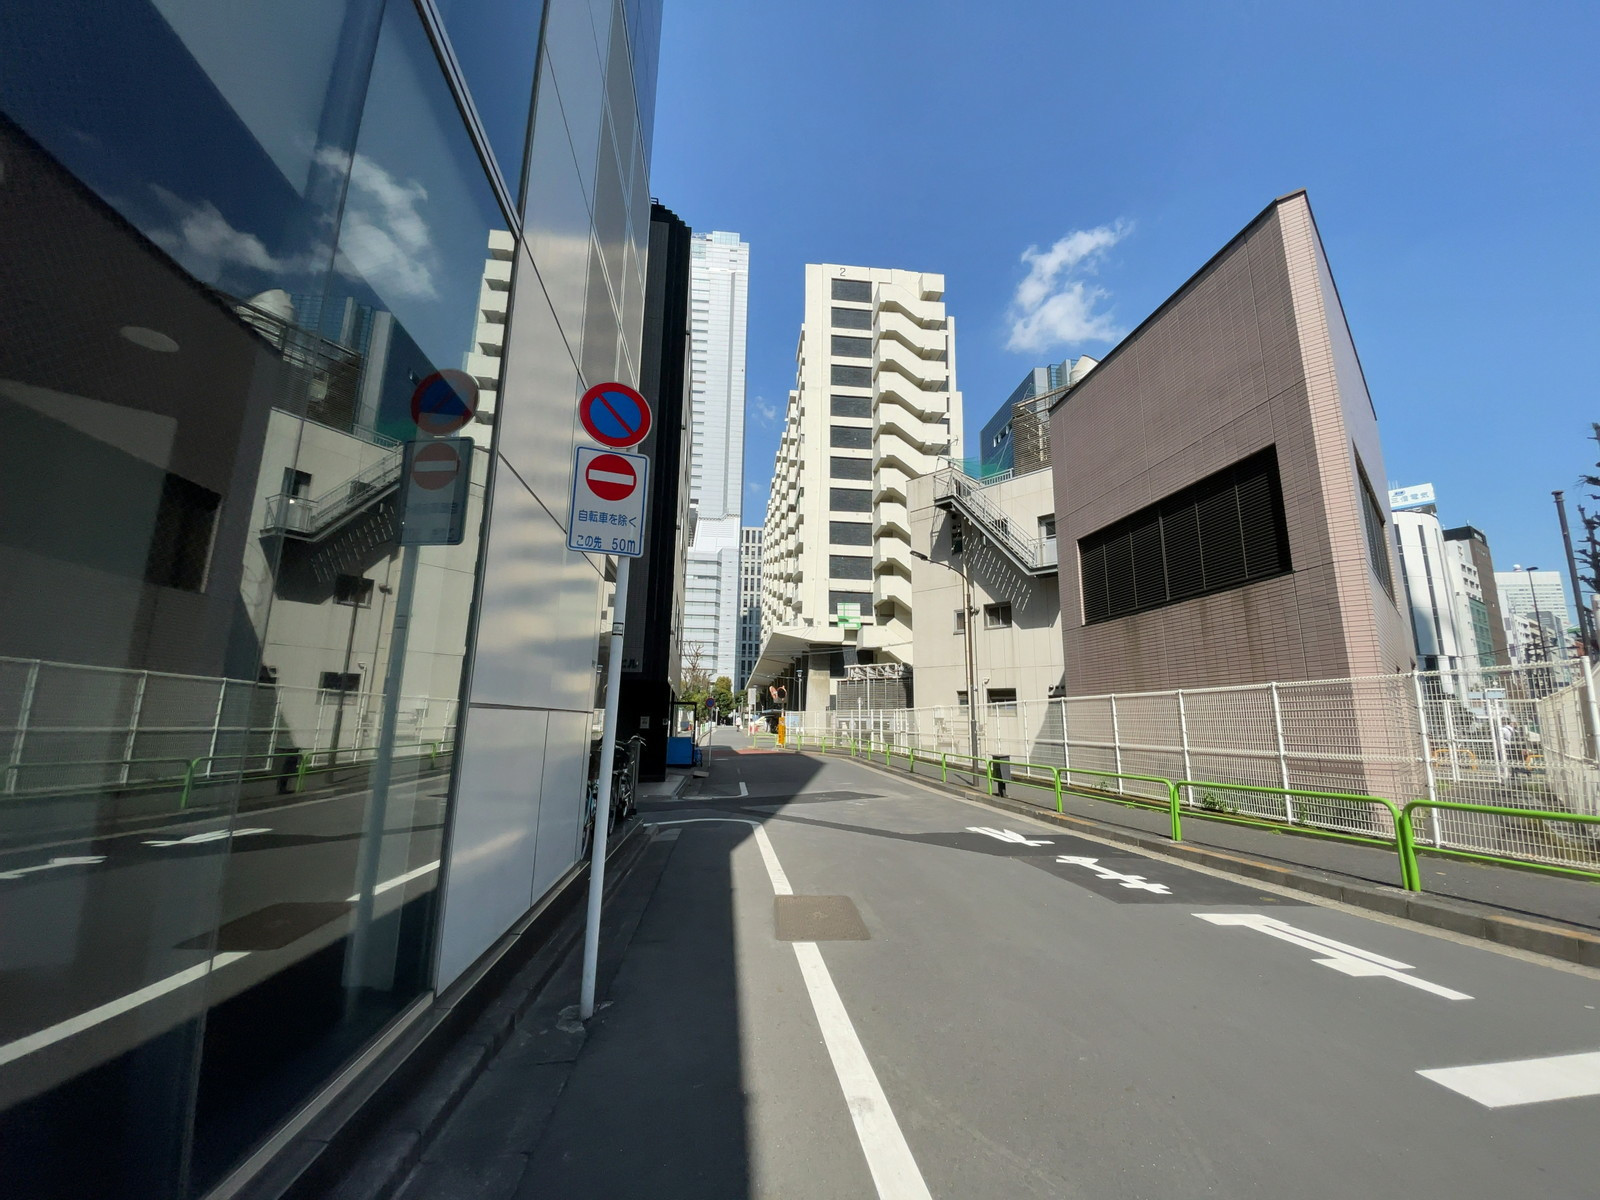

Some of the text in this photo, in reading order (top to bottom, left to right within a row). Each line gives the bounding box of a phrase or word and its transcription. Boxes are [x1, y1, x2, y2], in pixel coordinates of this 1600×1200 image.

[839, 267, 847, 277] 2
[578, 509, 637, 528] 自転車を除く
[576, 534, 636, 553] この先 50m
